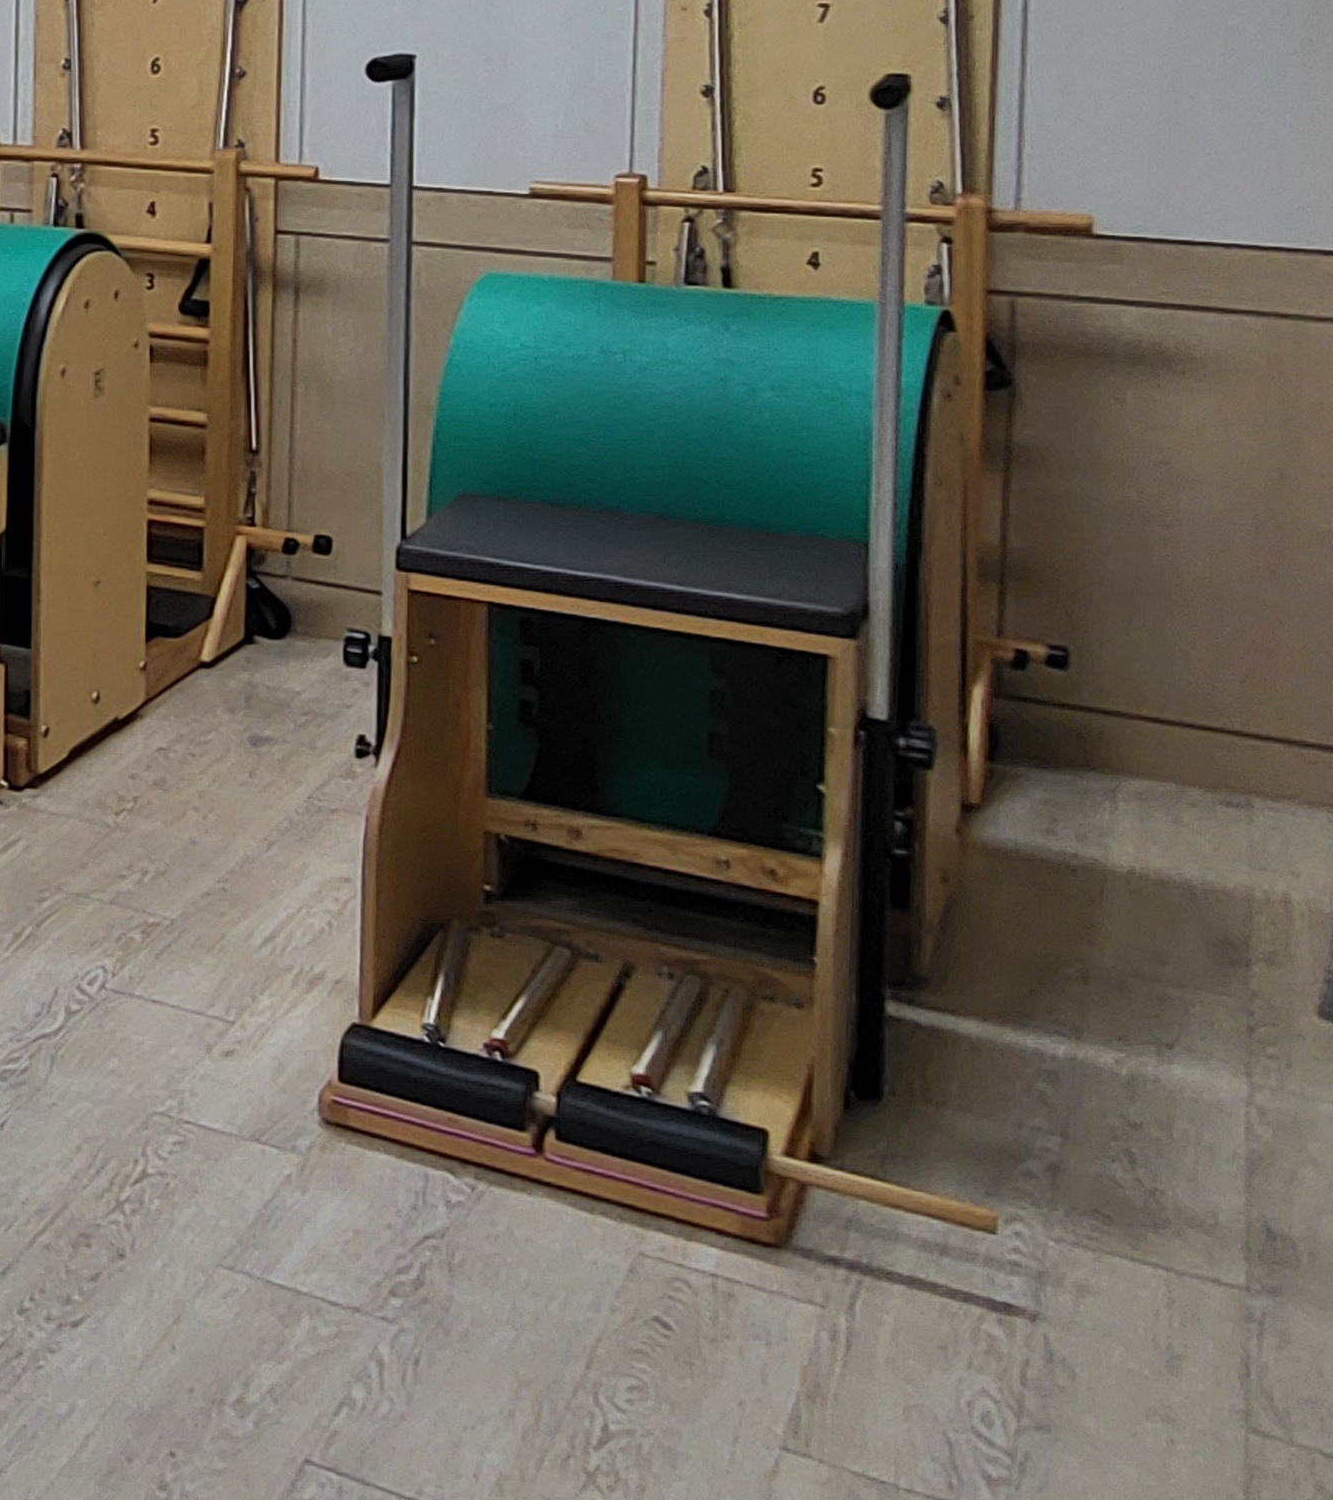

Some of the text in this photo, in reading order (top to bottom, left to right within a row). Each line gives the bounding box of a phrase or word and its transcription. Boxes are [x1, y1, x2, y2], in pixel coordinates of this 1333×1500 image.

[816, 2, 831, 24] 7
[150, 56, 162, 76] 6
[812, 85, 827, 106] 6
[148, 127, 160, 147] 5
[809, 167, 824, 189] 5
[145, 200, 157, 218] 4
[805, 251, 822, 271] 4
[145, 272, 156, 291] 3
